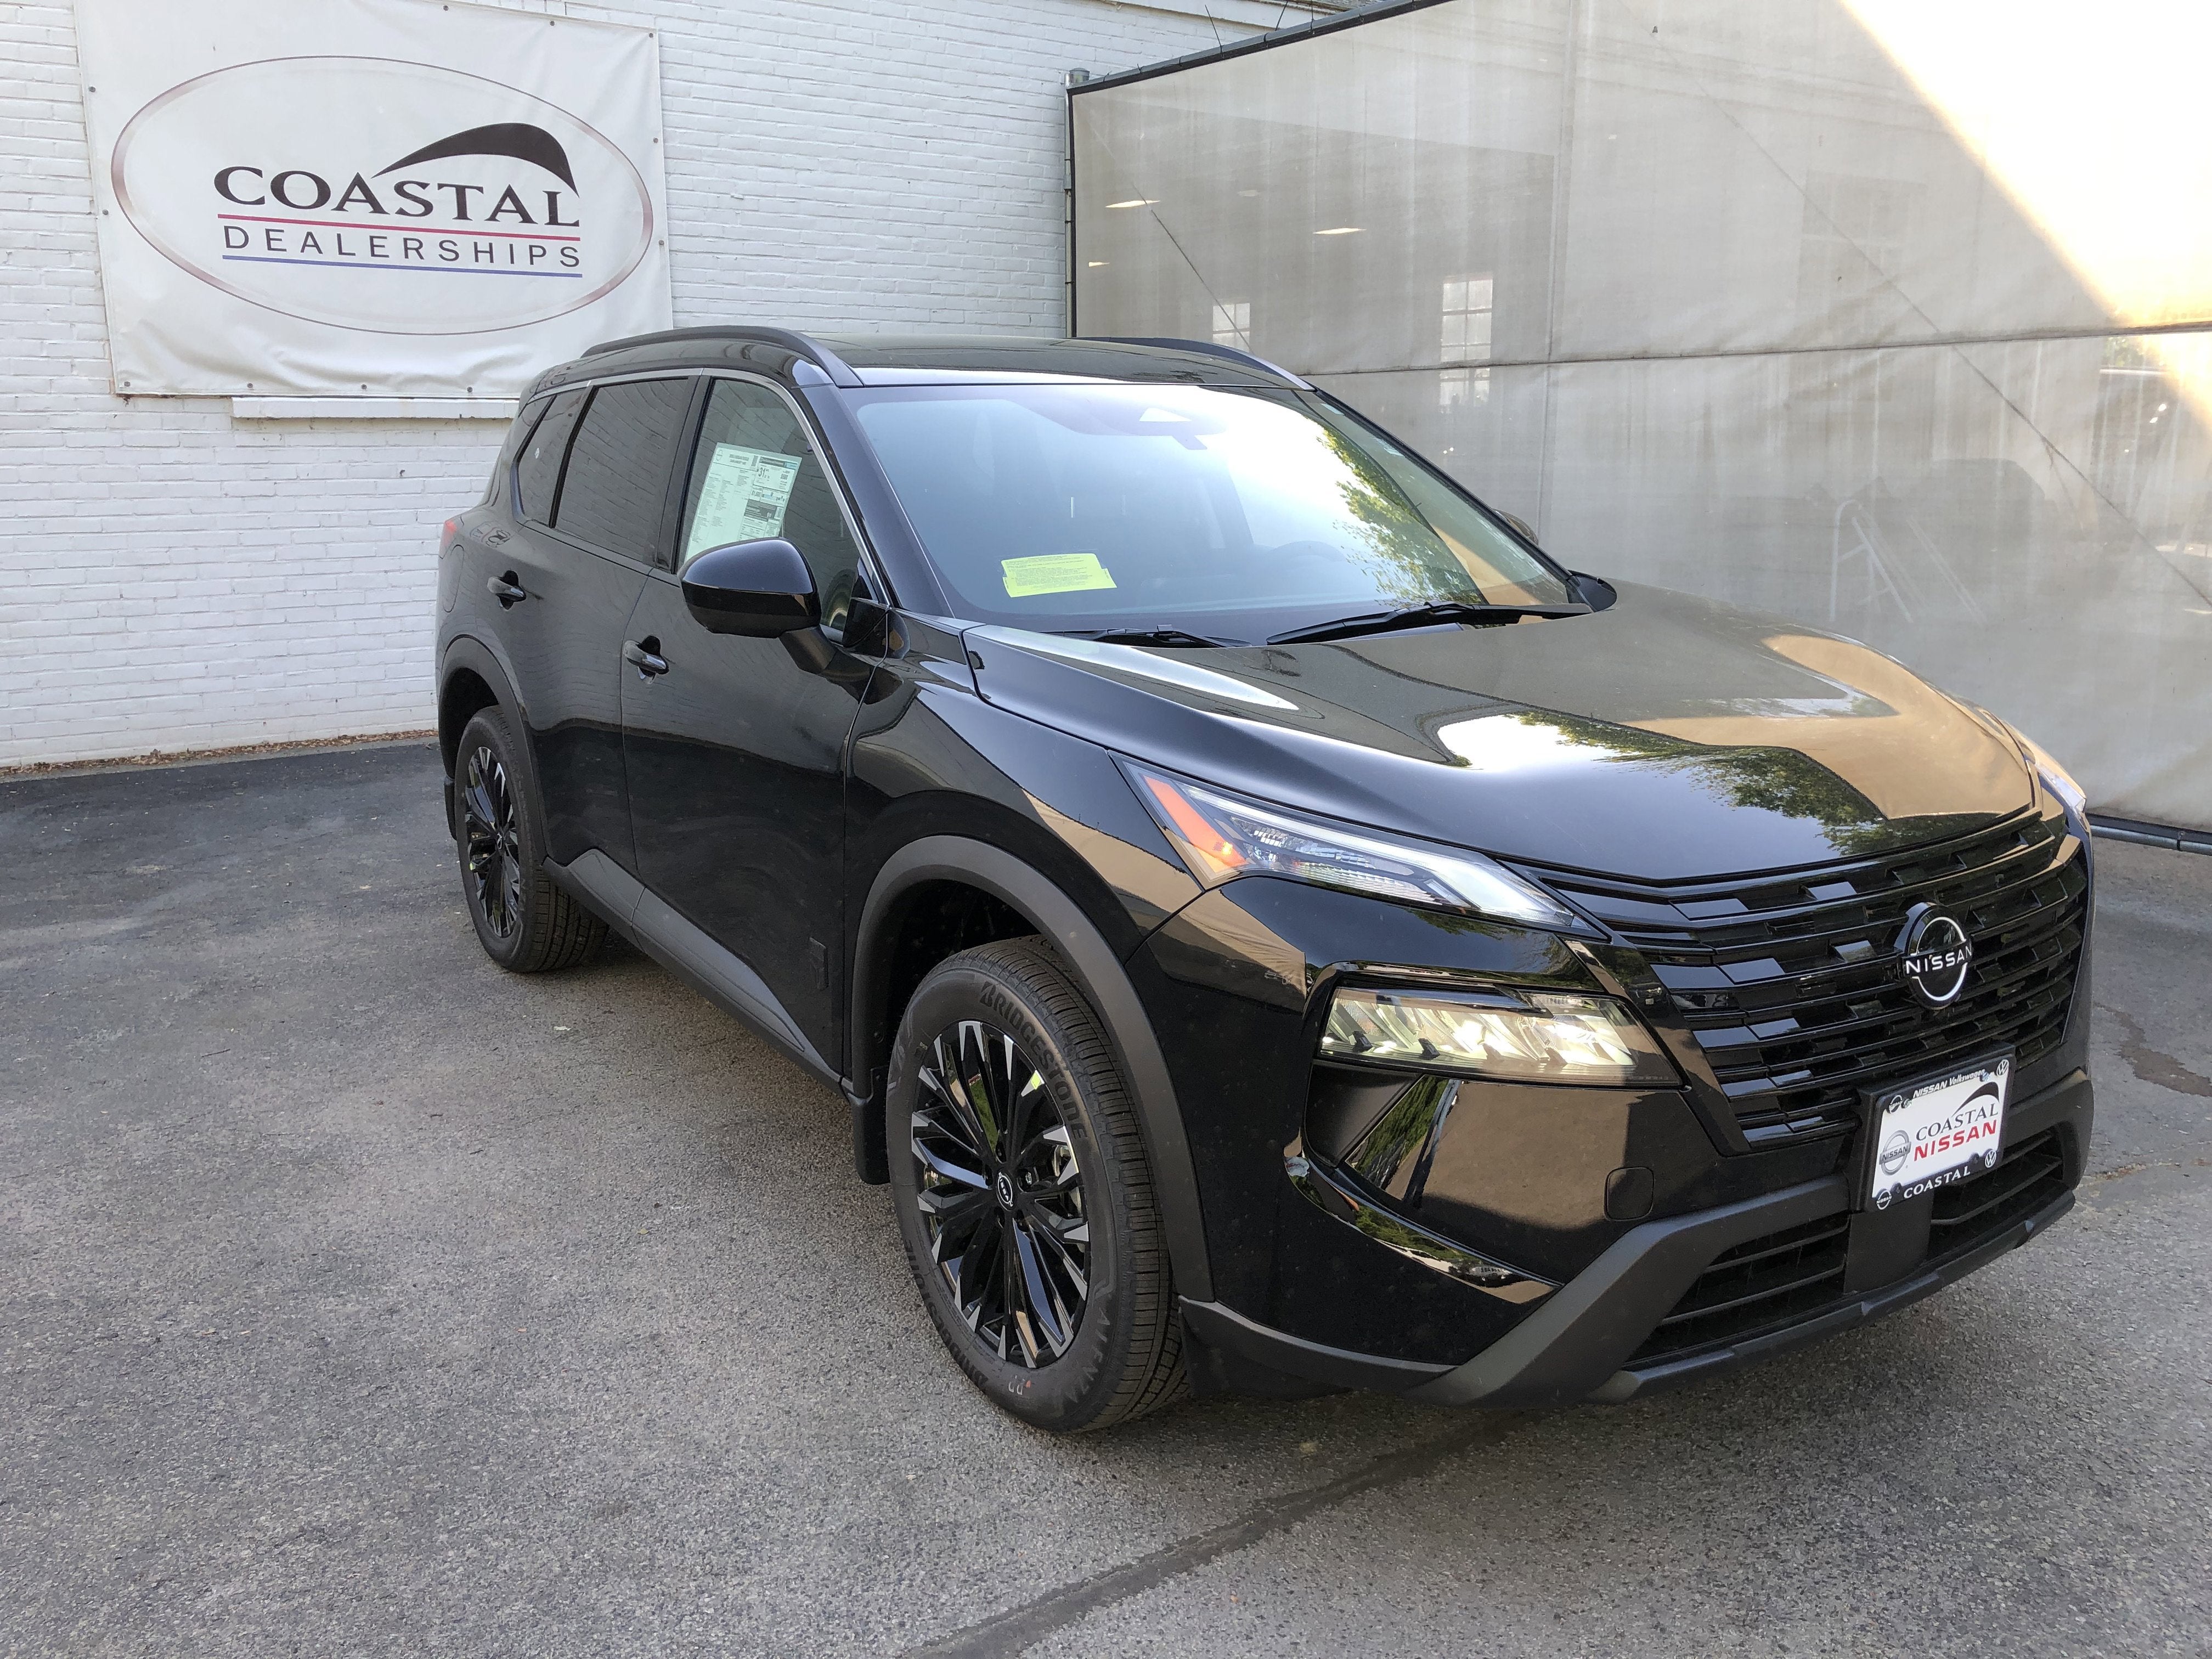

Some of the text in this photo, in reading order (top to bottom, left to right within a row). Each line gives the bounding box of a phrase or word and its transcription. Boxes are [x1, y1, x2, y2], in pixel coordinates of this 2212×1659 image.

[213, 165, 580, 228] COASTAL
[223, 225, 581, 268] DEALERSHIPS
[1905, 943, 1972, 974] NISSAN
[979, 980, 1088, 1139] BRIDGESTONE
[1912, 1069, 1985, 1098] NISSAN Volkswagen
[1914, 1119, 1997, 1161] NISSAN
[1916, 1103, 1999, 1142] COASTAL
[1881, 1144, 1909, 1162] NISSAN
[1903, 1165, 1971, 1199] COASTAL
